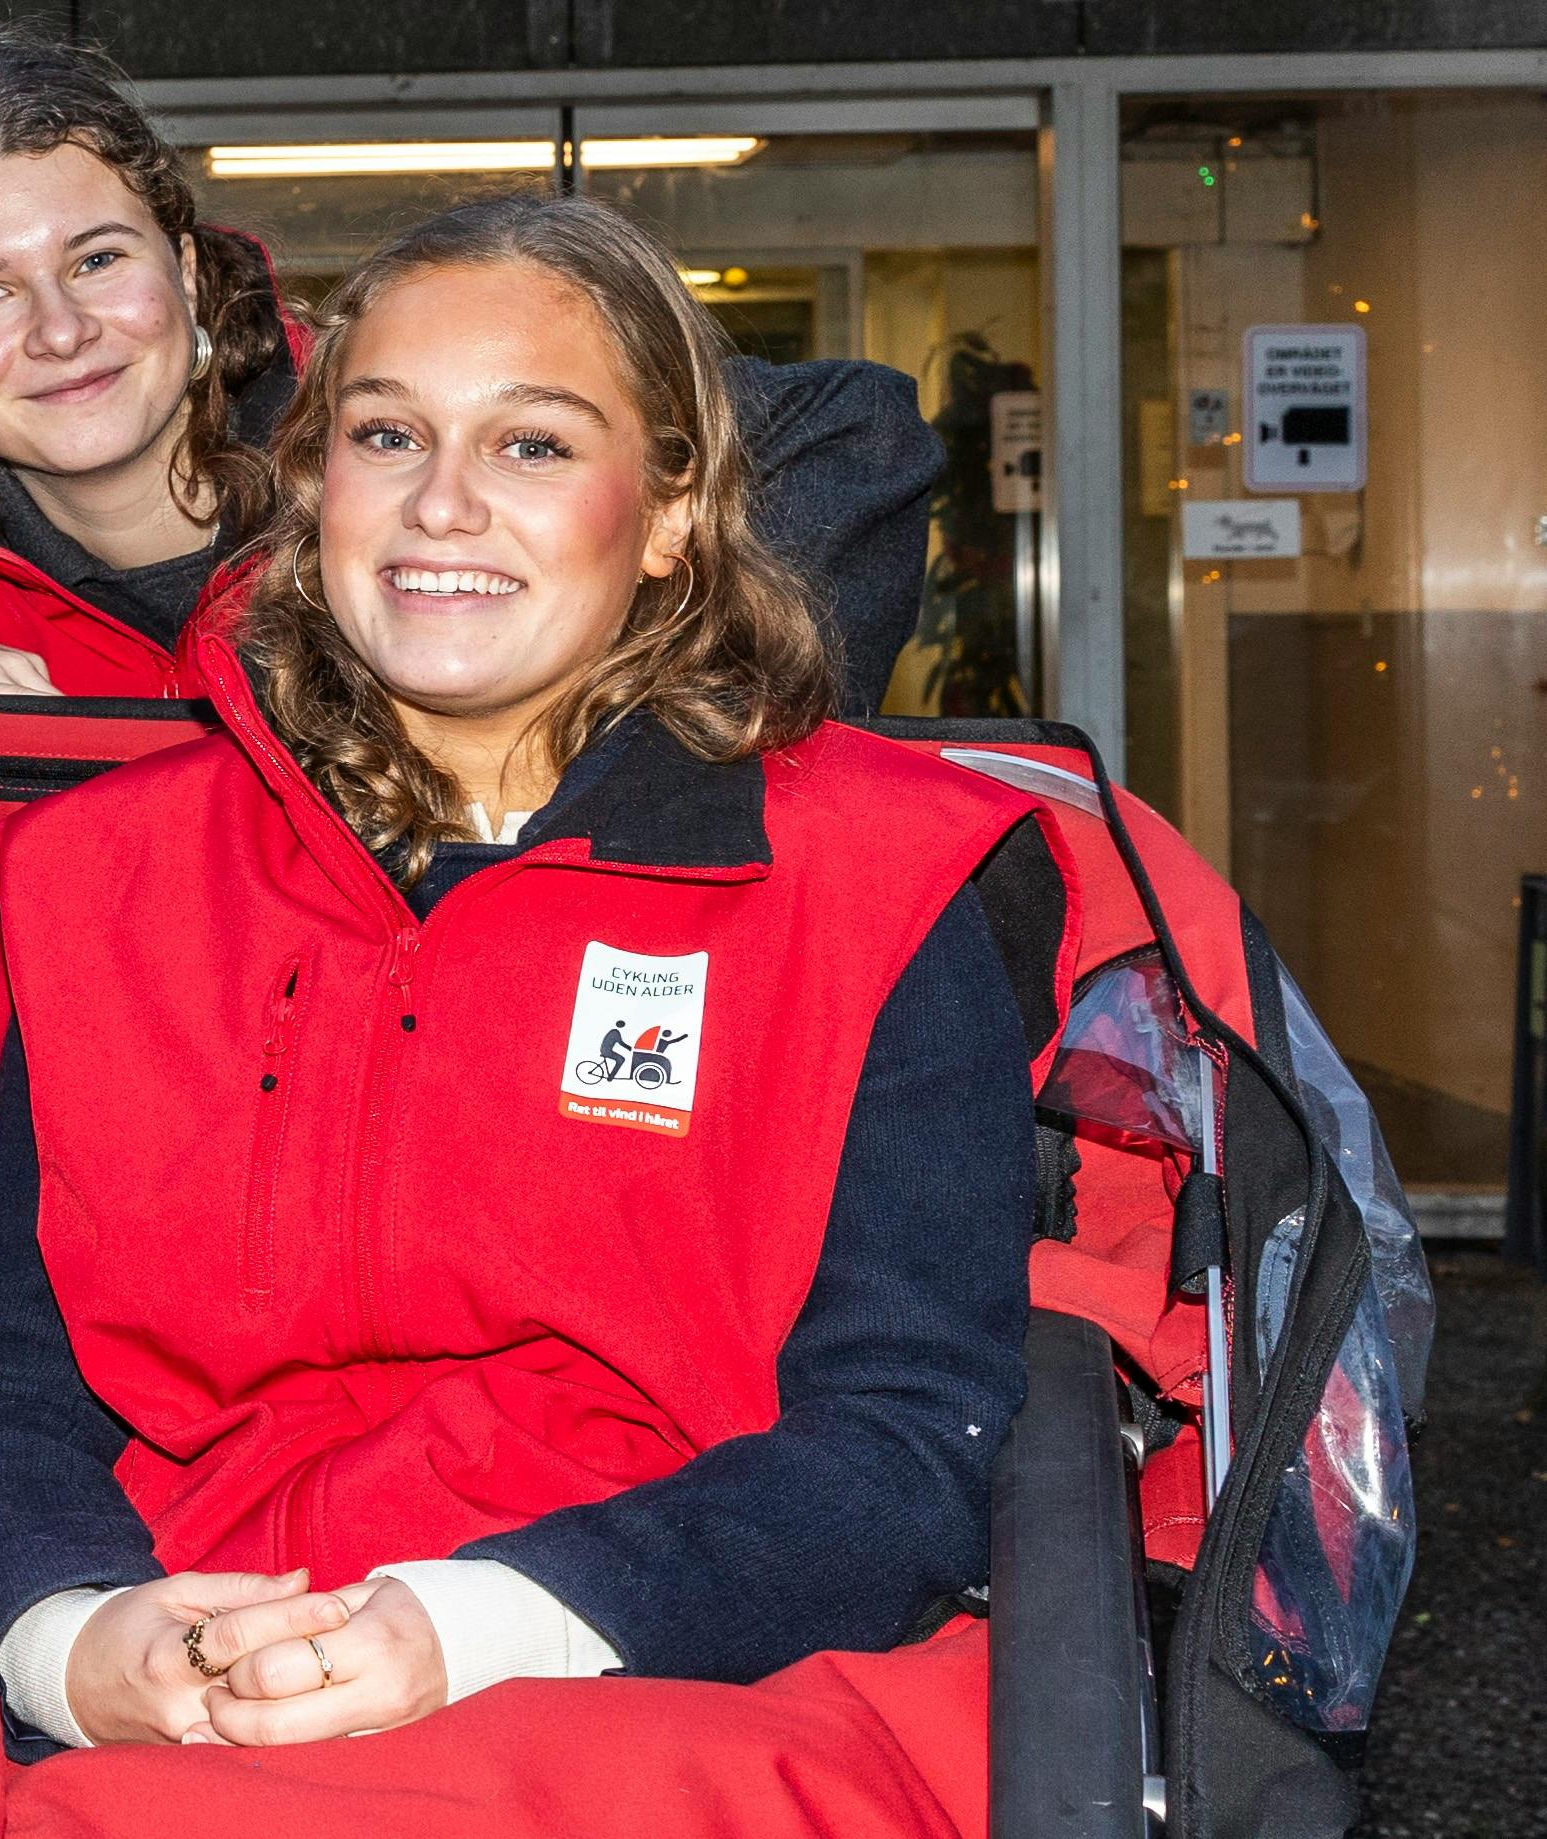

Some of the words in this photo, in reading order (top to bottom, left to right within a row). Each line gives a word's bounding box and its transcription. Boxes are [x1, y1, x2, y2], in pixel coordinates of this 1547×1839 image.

[612, 967, 679, 983] CYKLING
[592, 977, 637, 997] UDEN
[641, 984, 694, 997] ALDER
[568, 1101, 590, 1116] Ret
[592, 1106, 607, 1117] til
[609, 1108, 637, 1121] vind
[645, 1112, 680, 1130] håret
